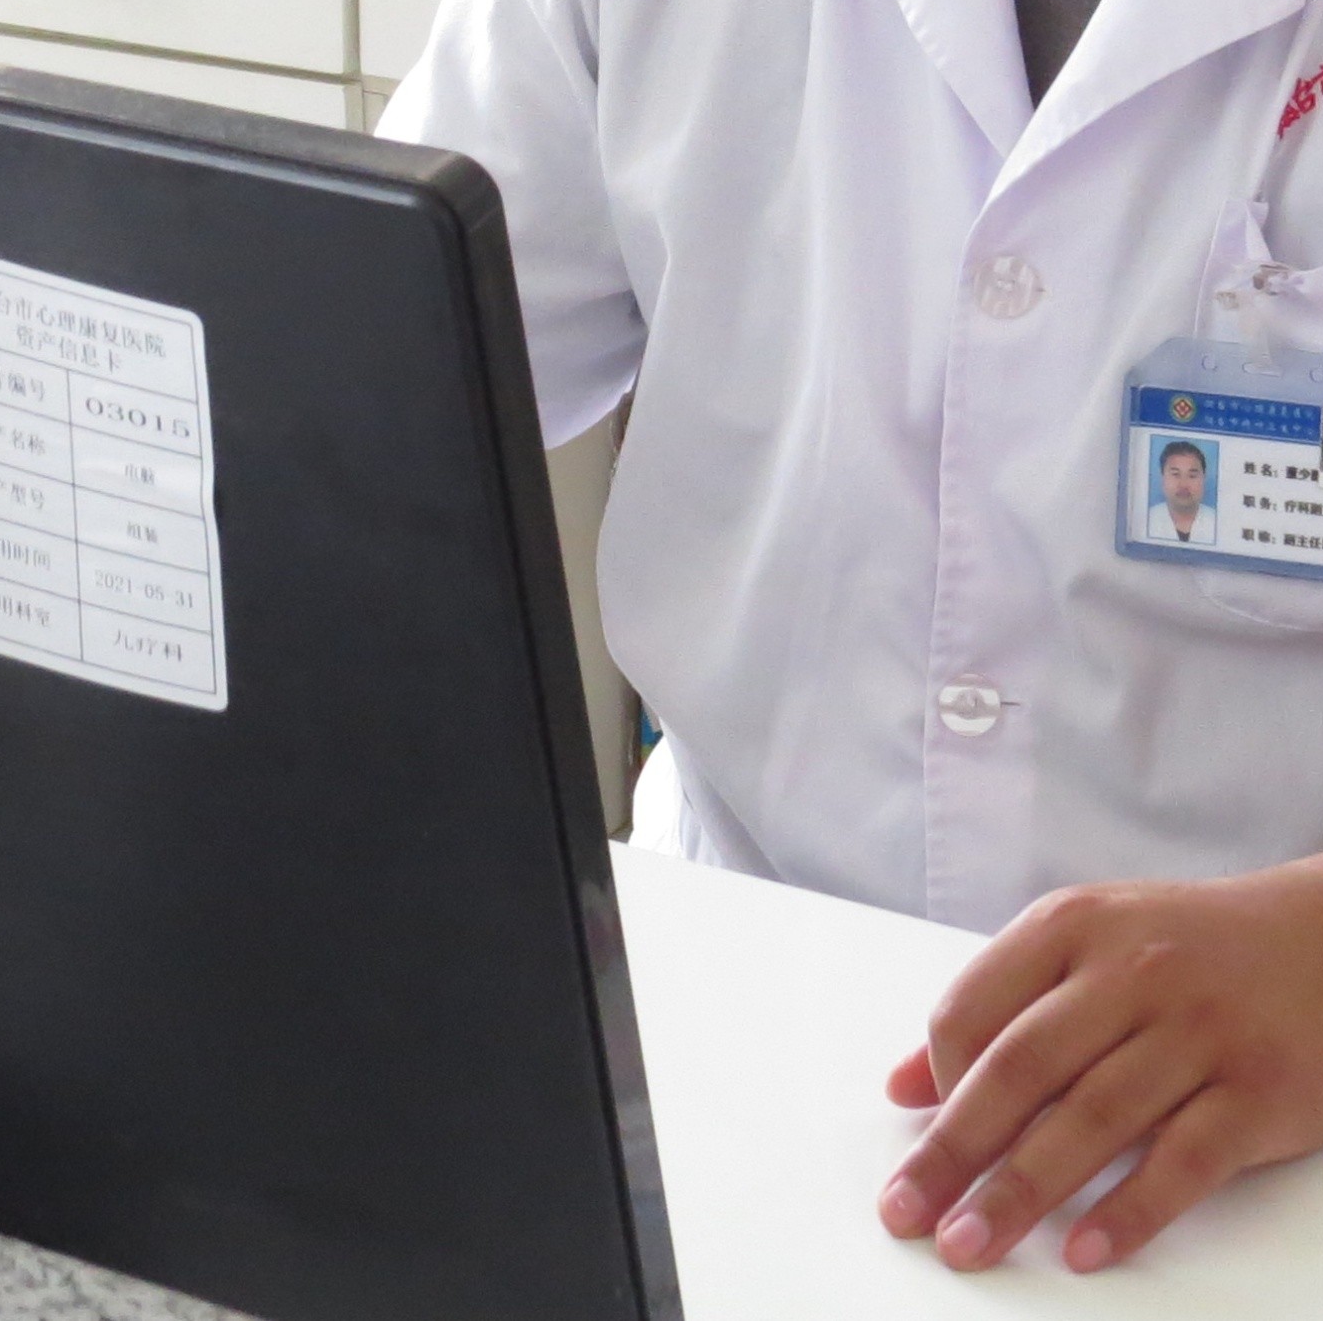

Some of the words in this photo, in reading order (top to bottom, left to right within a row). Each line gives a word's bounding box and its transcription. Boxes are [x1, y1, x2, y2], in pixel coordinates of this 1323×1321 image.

[15, 324, 123, 373] 资产信息卡
[85, 397, 191, 439] 03015
